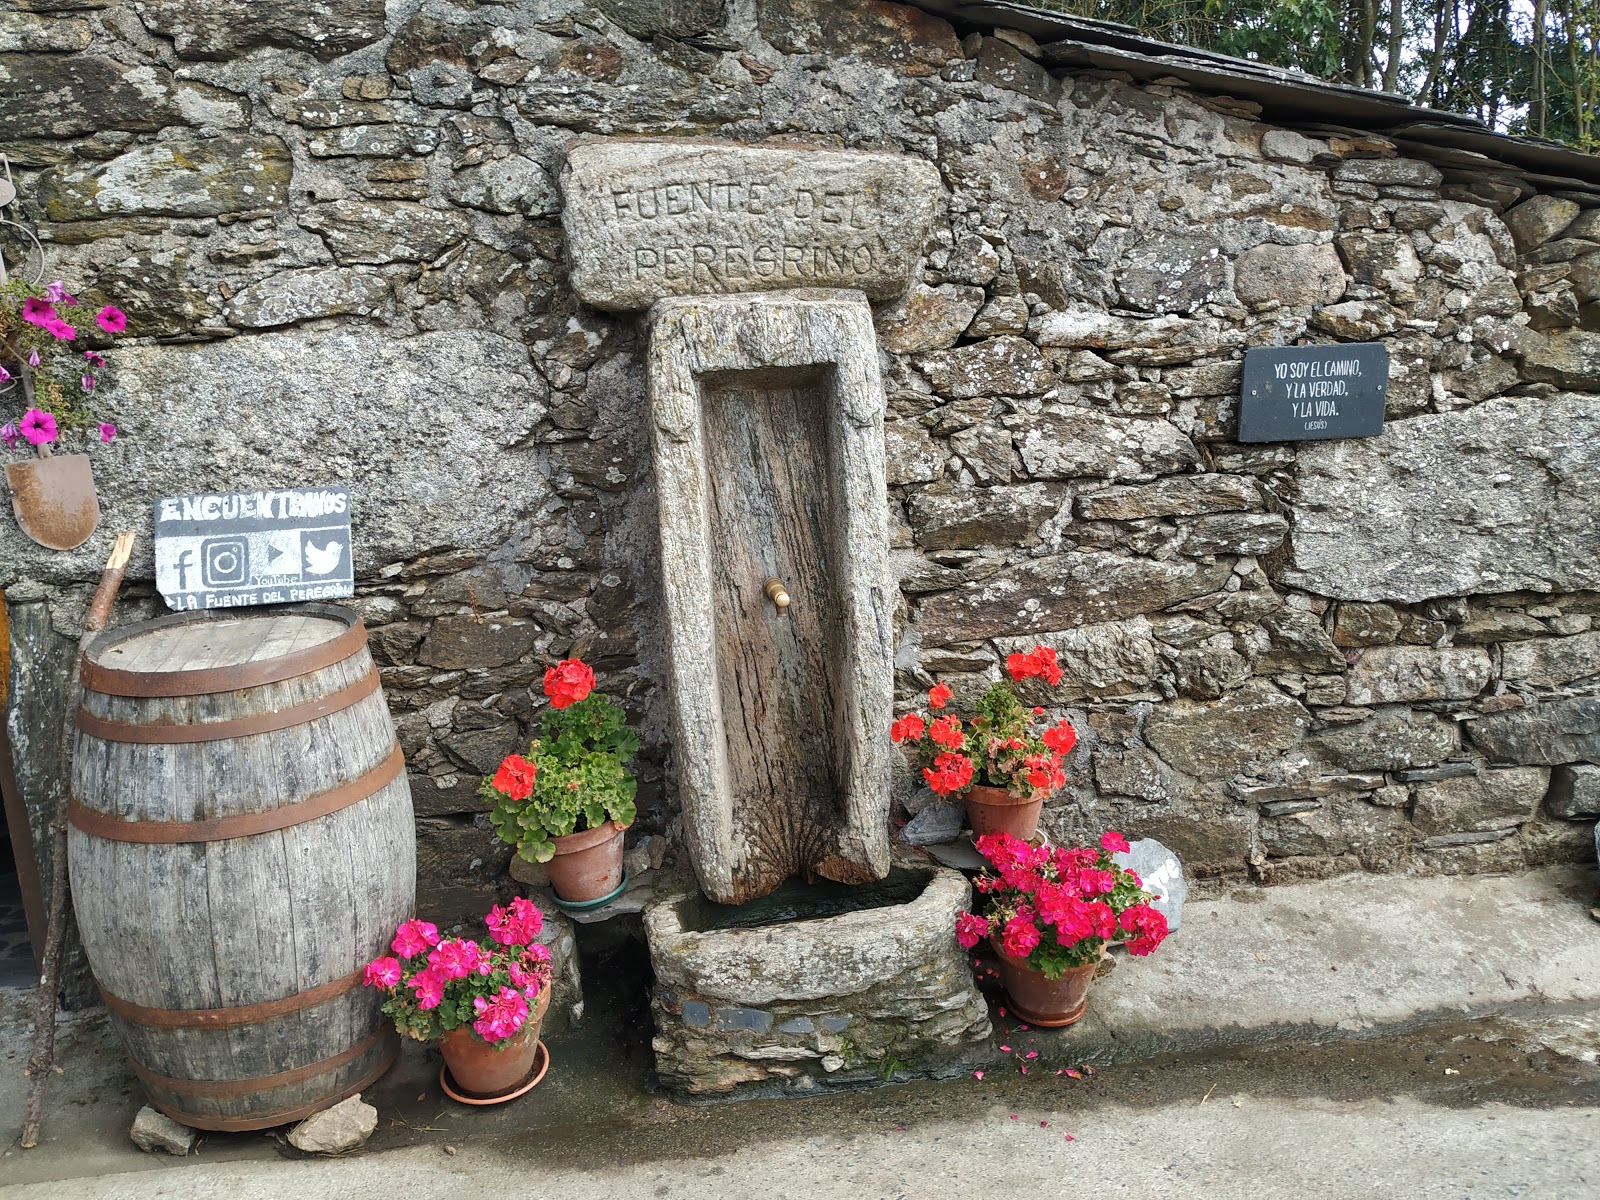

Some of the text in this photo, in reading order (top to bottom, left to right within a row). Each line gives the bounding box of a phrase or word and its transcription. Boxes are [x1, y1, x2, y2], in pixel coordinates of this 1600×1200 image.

[611, 181, 868, 230] FUENTE DEL
[634, 244, 873, 287] PEREGRINO
[1274, 359, 1362, 379] YO SOY EL CAMINO,
[1309, 380, 1349, 398] VERDAD,
[1292, 401, 1340, 418] Y LA VIDA.
[255, 574, 298, 586] YouTube
[177, 594, 198, 611] LA
[263, 591, 285, 604] DEL
